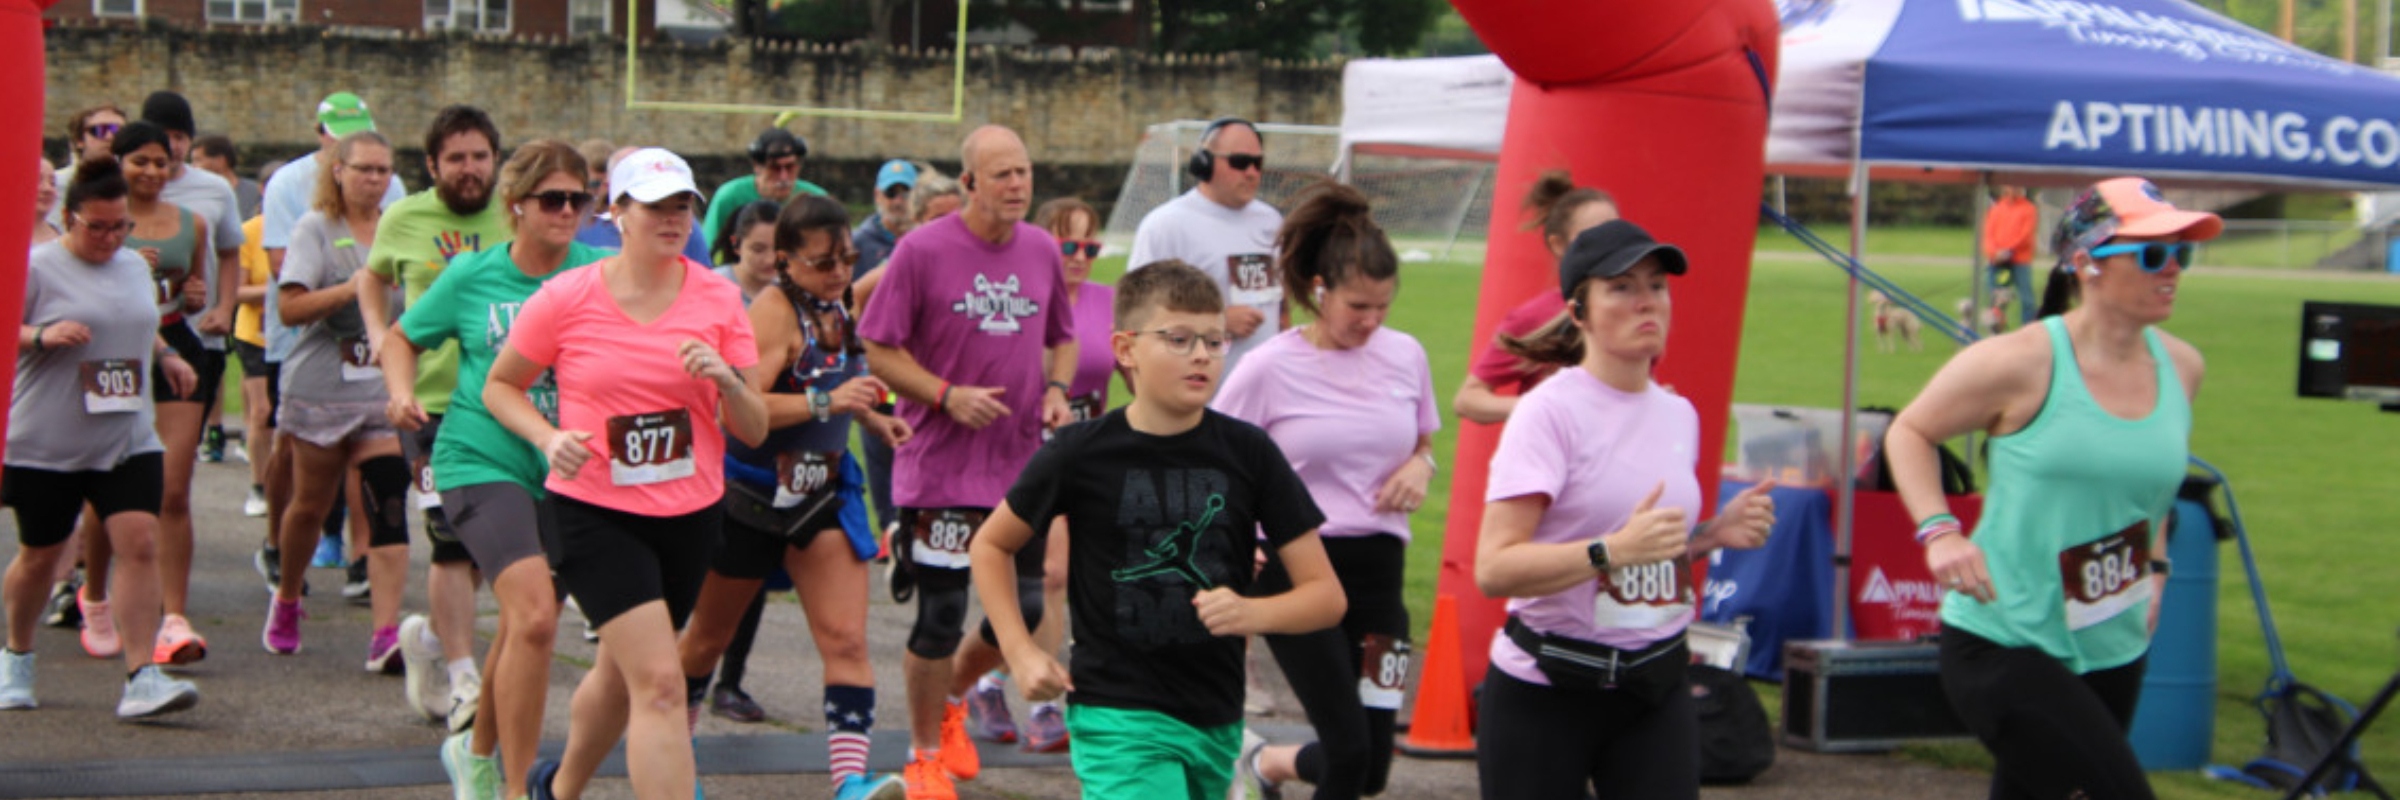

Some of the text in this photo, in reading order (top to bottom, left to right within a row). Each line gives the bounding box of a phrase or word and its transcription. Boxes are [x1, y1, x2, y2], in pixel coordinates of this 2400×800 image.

[2046, 100, 2400, 169] APTIMING.CO
[1237, 263, 1268, 288] 925
[97, 370, 134, 395] 903
[625, 426, 675, 463] 877
[791, 462, 828, 491] 890
[1116, 467, 1231, 526] AIR
[930, 520, 971, 551] 882
[1621, 559, 1677, 600] 880
[2083, 545, 2137, 599] 884
